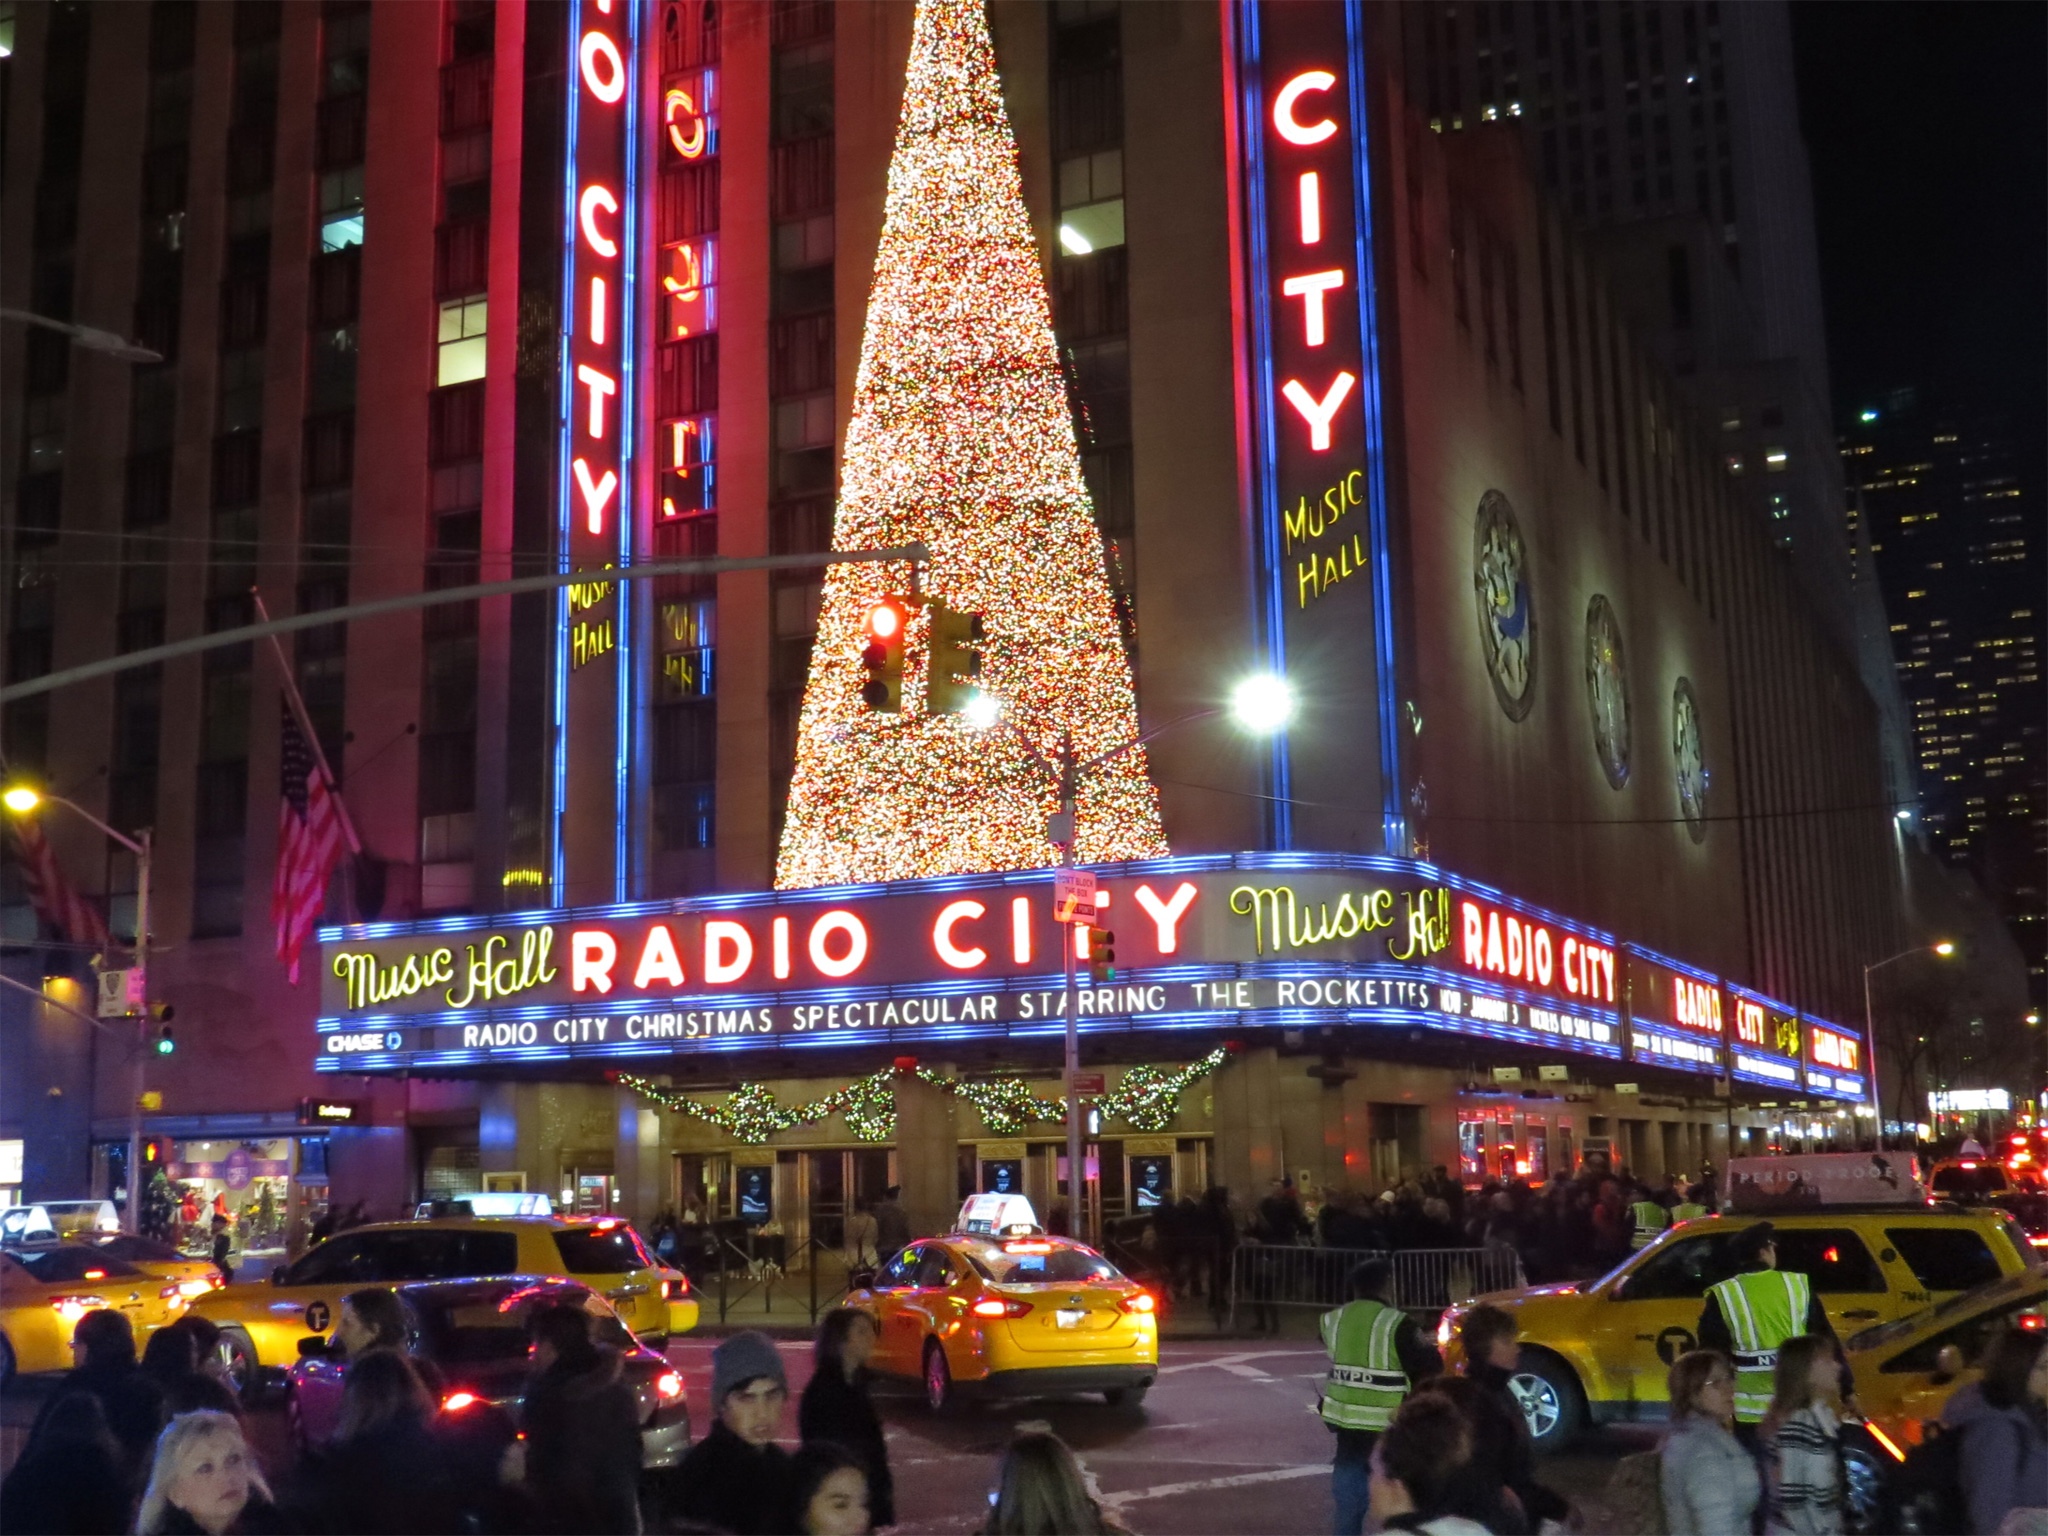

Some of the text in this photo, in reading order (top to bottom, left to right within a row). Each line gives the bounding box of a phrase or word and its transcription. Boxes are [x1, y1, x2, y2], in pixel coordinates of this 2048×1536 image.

[580, 0, 624, 103] O
[1273, 70, 1355, 451] CITY
[573, 184, 617, 535] CITY
[1284, 470, 1363, 556] MUSIC
[1298, 534, 1367, 609] HALL
[573, 619, 613, 670] HALL
[571, 909, 868, 994] RADIO
[1230, 885, 1394, 955] Music
[1462, 901, 1614, 1002] RADIO CITY
[334, 925, 557, 1010] Music Hall
[327, 1033, 384, 1053] CHASE
[464, 1021, 538, 1047] RADIO
[553, 1017, 609, 1043] CITY
[625, 1008, 773, 1040] CHRISTMAS
[792, 995, 998, 1031] SPECTACULAR
[1191, 981, 1251, 1008] THE
[1278, 979, 1429, 1009] ROCKETTES
[1674, 977, 1722, 1033] RADIO
[1736, 998, 1764, 1045] CITY
[1739, 1170, 1813, 1184] PERIOD
[1333, 1369, 1373, 1383] NYPD
